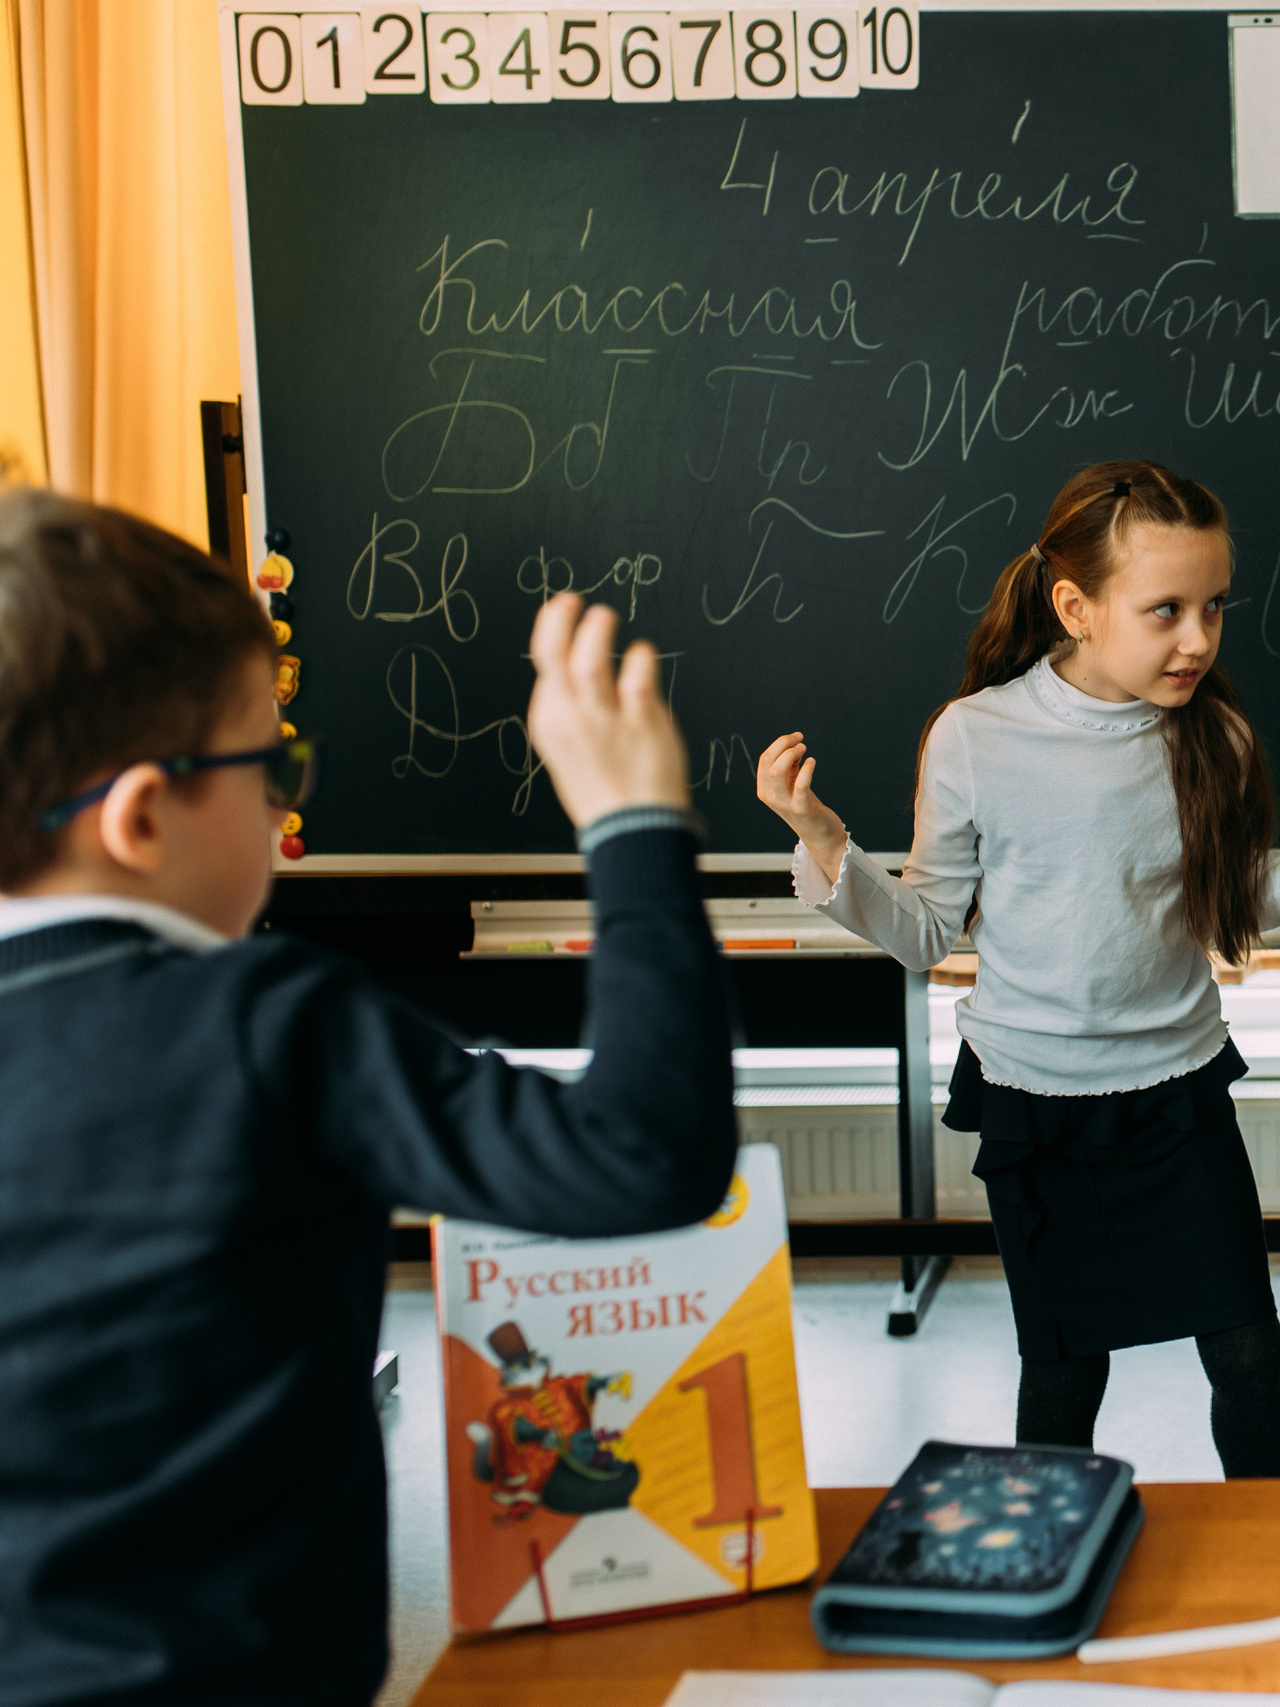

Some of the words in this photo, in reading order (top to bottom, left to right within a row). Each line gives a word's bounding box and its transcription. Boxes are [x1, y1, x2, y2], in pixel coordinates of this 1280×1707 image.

[249, 25, 293, 93] 0
[315, 25, 342, 89] 1
[372, 14, 417, 81] 2
[440, 27, 481, 91] 3
[499, 29, 541, 91] 4
[557, 20, 602, 88] 5
[620, 25, 662, 89] 6
[679, 20, 723, 88] 7
[743, 19, 787, 88] 8
[806, 18, 849, 82] 9
[862, 6, 913, 76] 10
[719, 117, 779, 216] 4
[465, 1256, 652, 1310] Русский
[676, 1351, 783, 1529] 1
